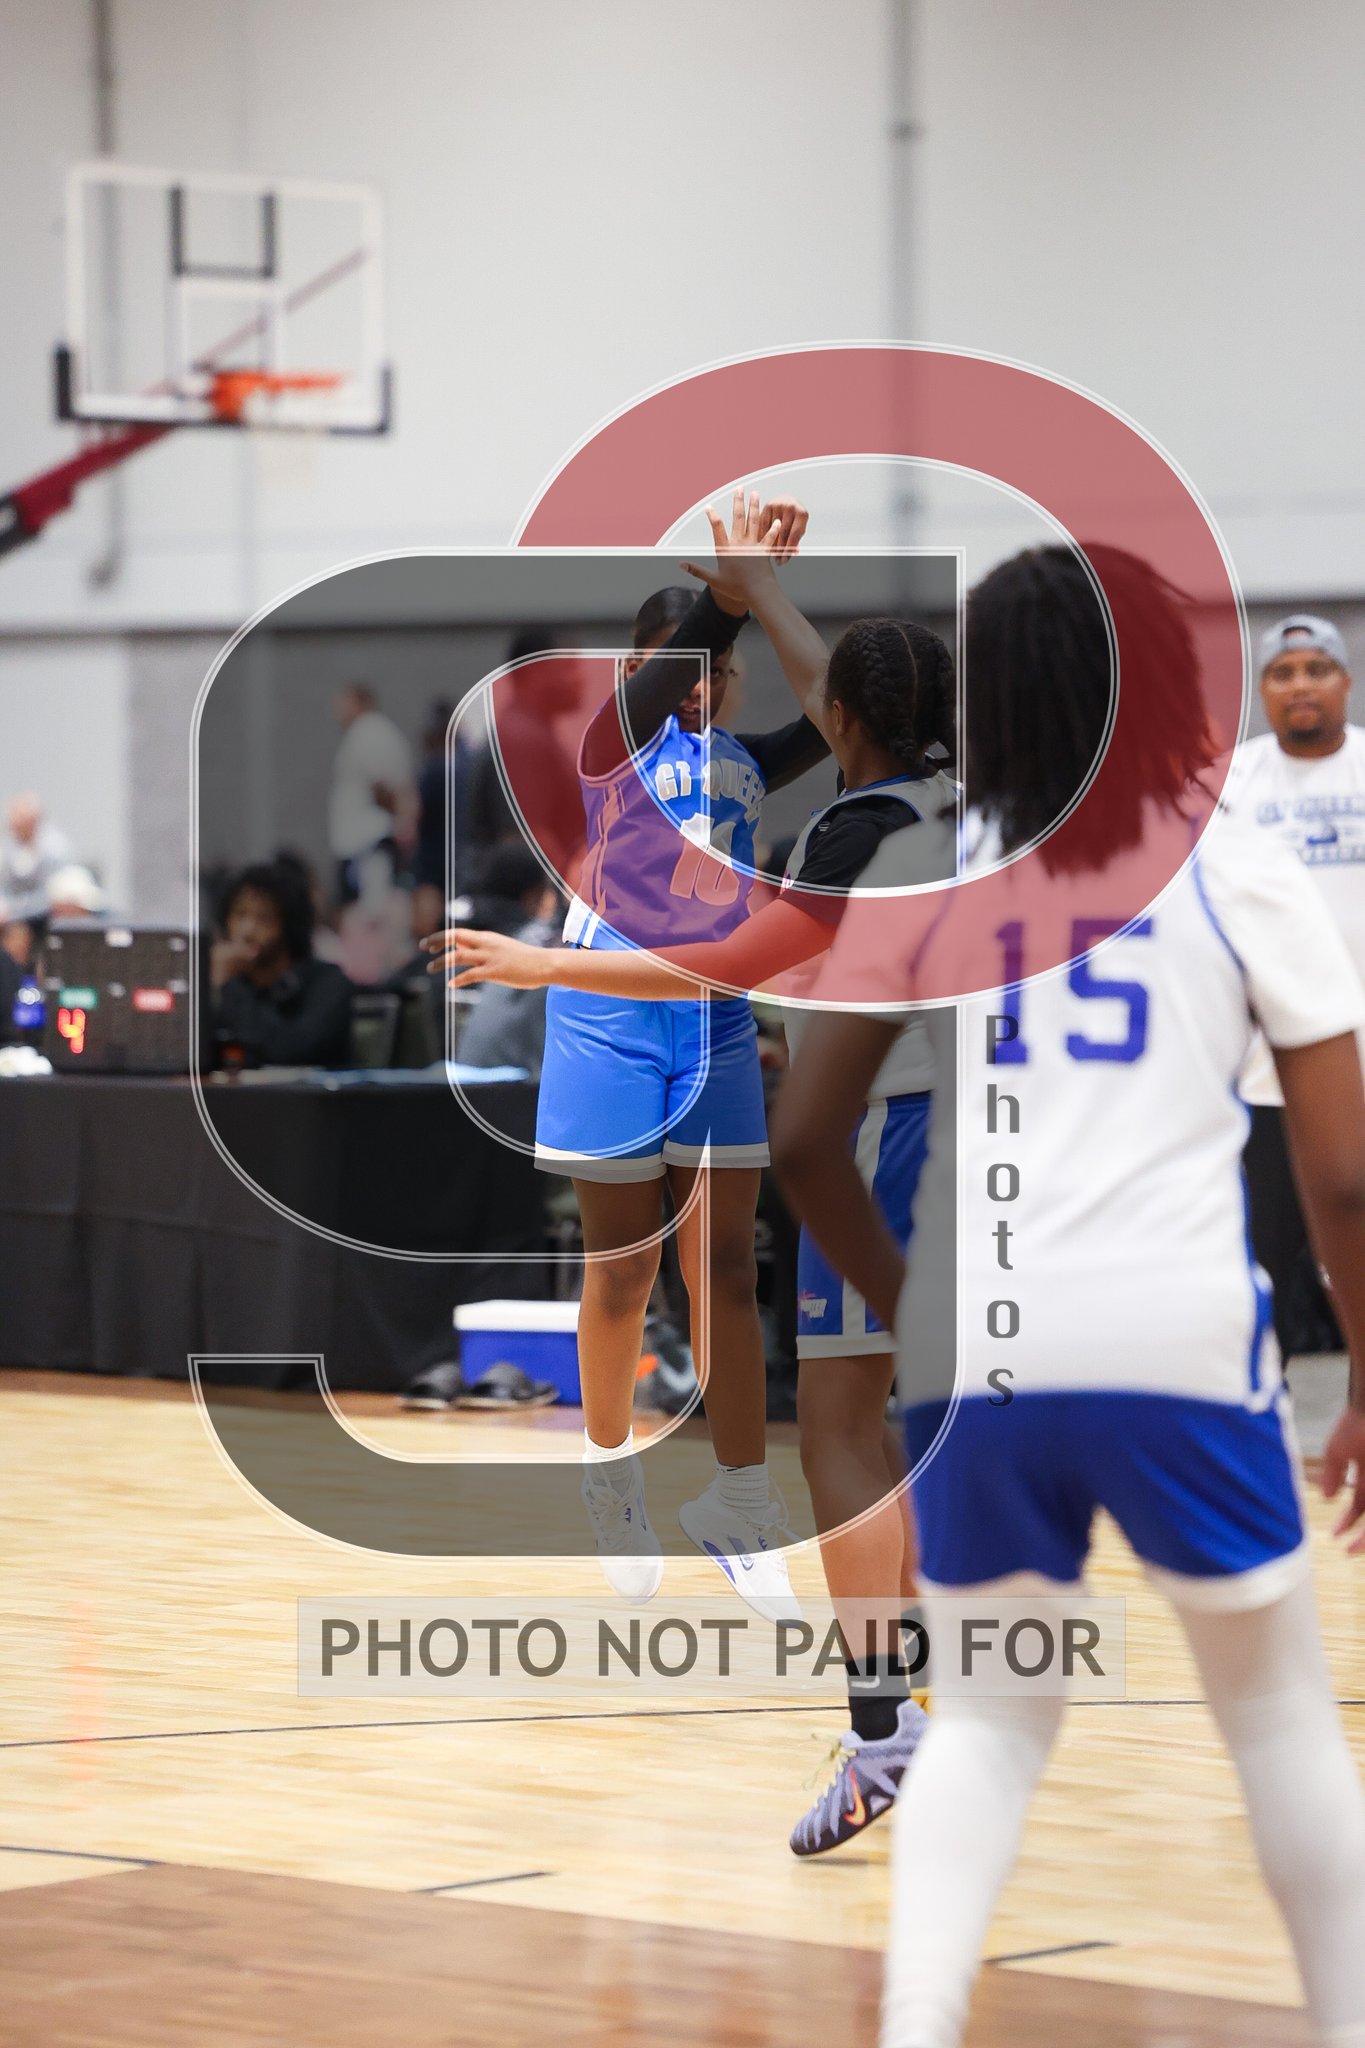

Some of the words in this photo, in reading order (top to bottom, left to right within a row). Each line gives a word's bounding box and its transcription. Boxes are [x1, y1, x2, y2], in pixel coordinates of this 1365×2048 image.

[669, 812, 741, 906] 10
[58, 1007, 86, 1053] 4
[995, 919, 1154, 1064] 15
